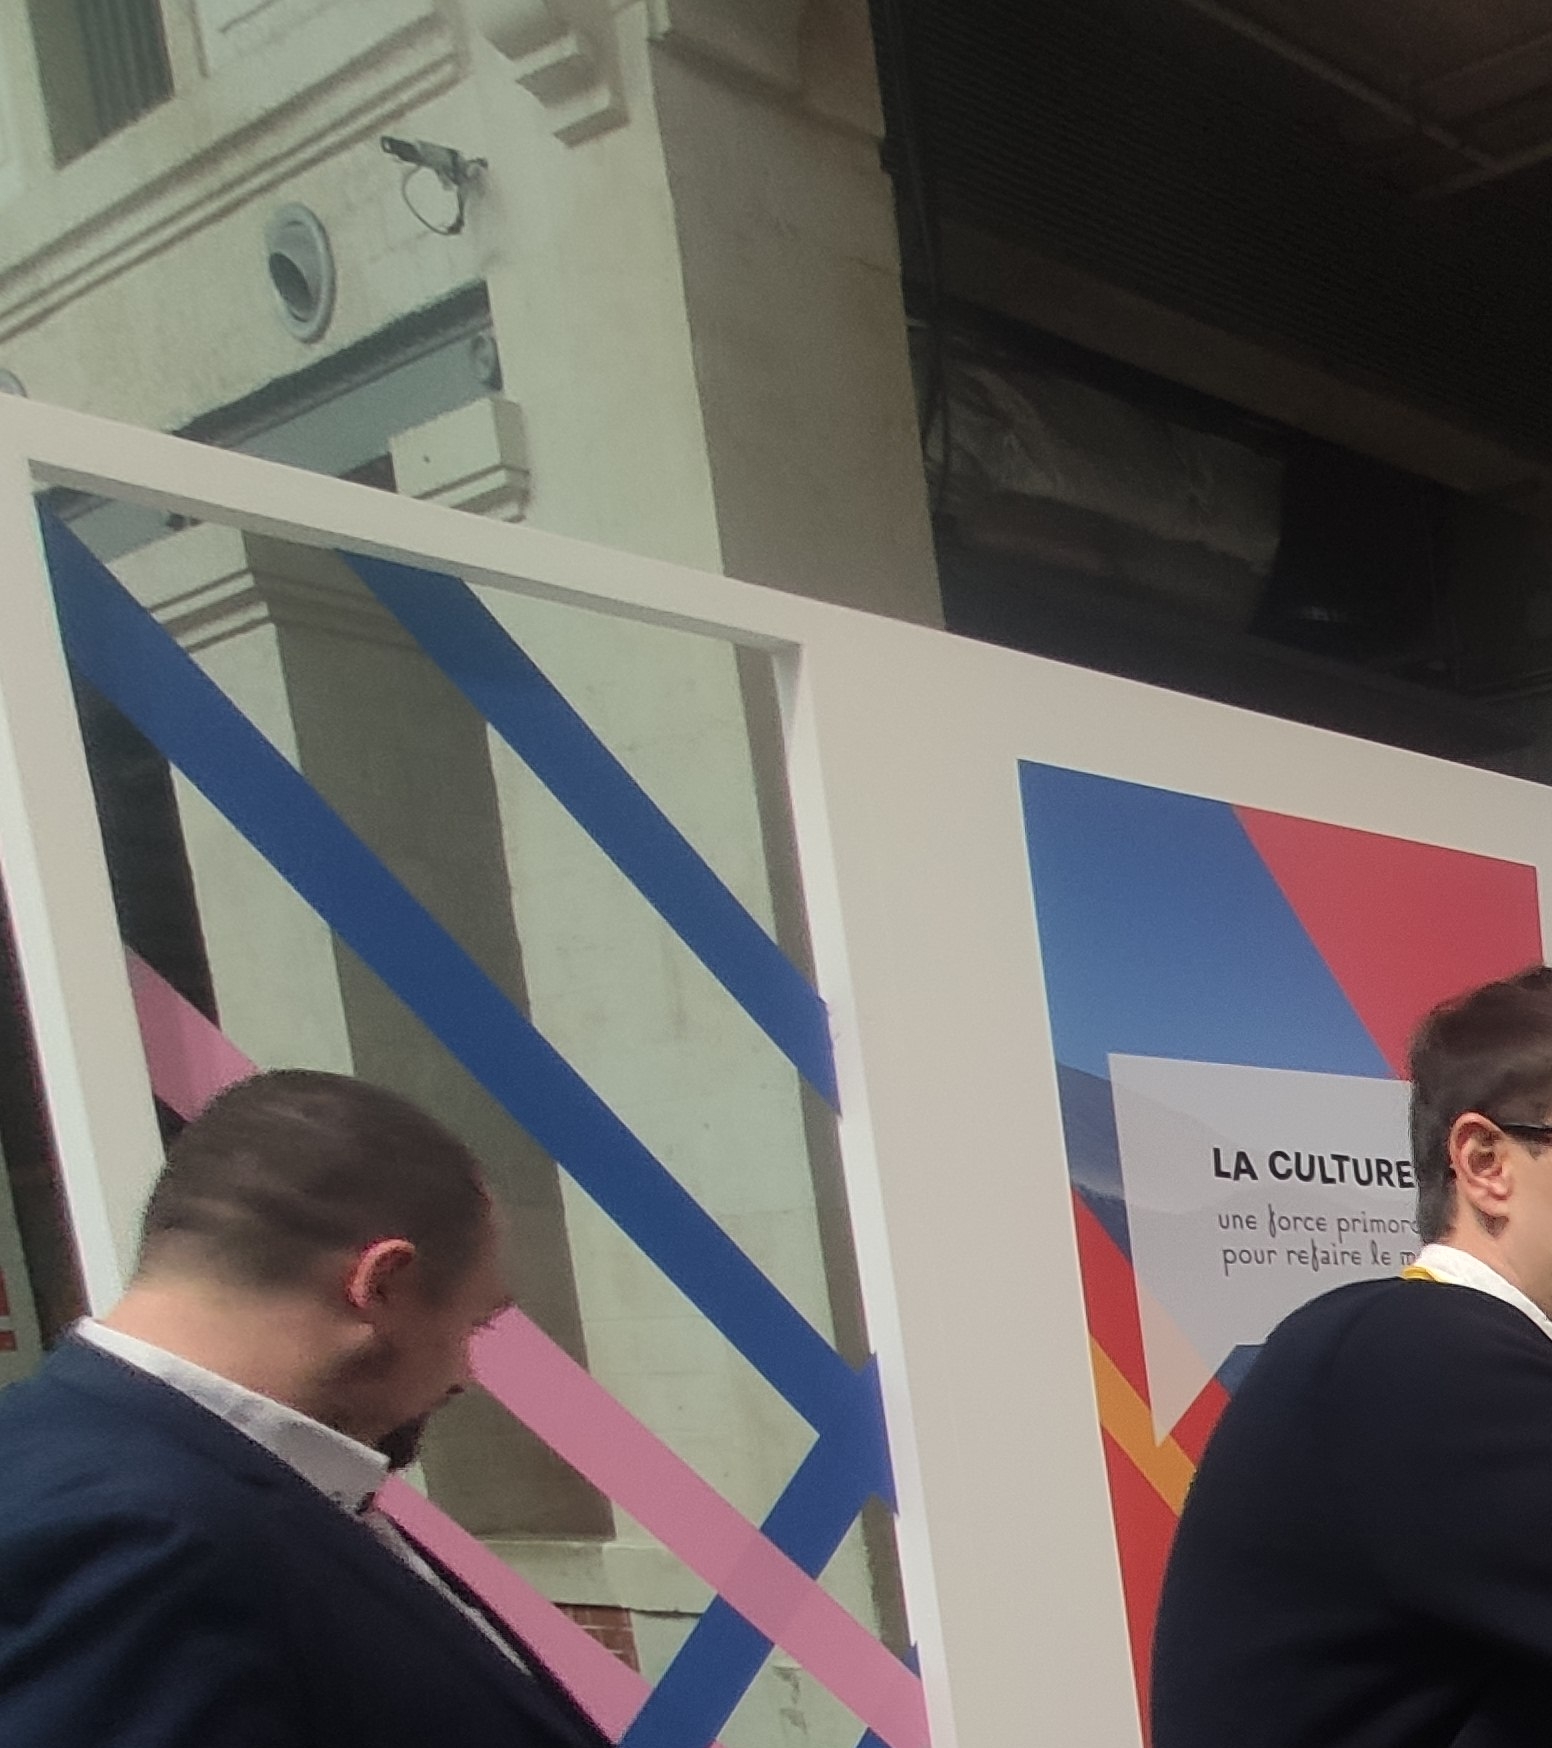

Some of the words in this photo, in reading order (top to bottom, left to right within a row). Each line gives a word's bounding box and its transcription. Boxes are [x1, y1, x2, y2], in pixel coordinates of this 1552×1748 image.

[1212, 1147, 1259, 1181] LA
[1268, 1150, 1415, 1189] CULTURE
[1218, 1213, 1257, 1230] une
[1267, 1203, 1328, 1238] force
[1222, 1248, 1277, 1276] pour
[1287, 1238, 1362, 1272] refaire
[1371, 1240, 1392, 1266] le
